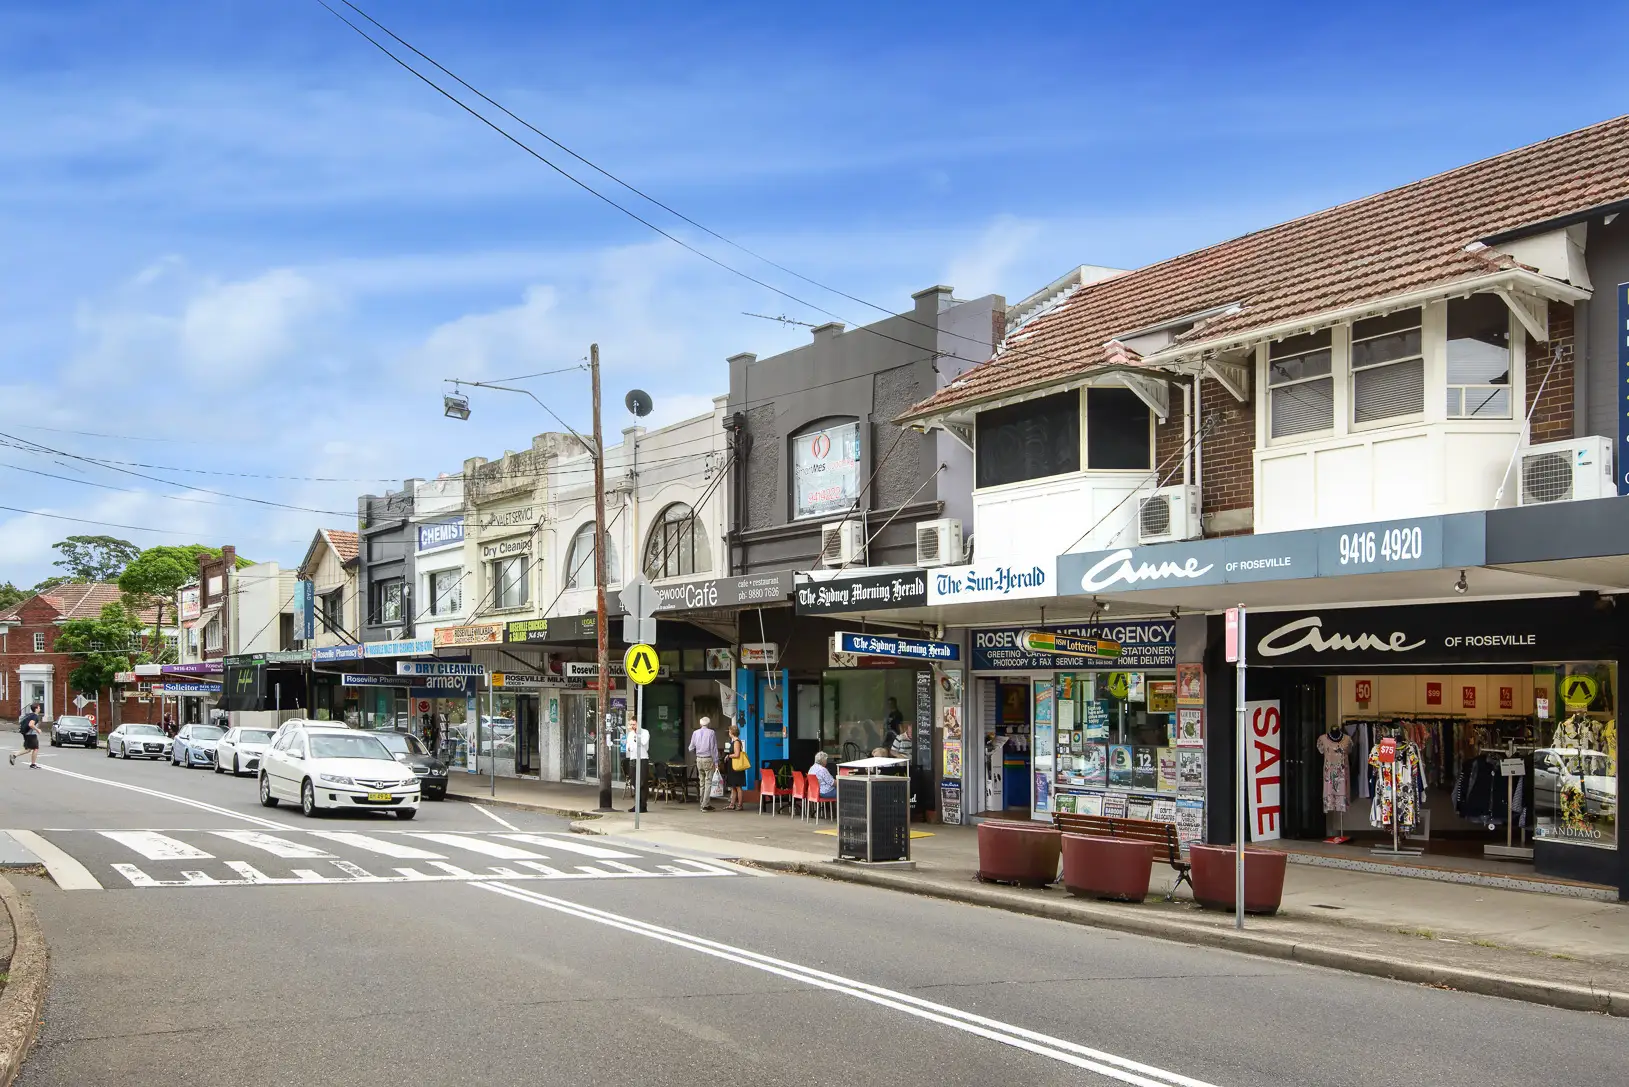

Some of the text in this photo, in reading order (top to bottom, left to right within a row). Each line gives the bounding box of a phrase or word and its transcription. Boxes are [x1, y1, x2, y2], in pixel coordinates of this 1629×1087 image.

[421, 519, 464, 545] CHEMIST
[484, 540, 533, 557] Dry Cleaning
[1226, 526, 1422, 572] OF ROSEVILLE 9416 4920
[752, 576, 779, 585] restaurant
[936, 566, 1045, 596] The Sun-Herald
[656, 581, 718, 608] ewood Café
[748, 589, 763, 599] 9880
[799, 577, 925, 606] The Sydney Morning Herald
[977, 625, 1175, 648] ROSEV WAGENCY
[1445, 637, 1462, 646] OF
[1465, 634, 1536, 646] ROSEVILLE
[853, 637, 951, 657] The Sydney Morning Herald
[1055, 638, 1097, 653] NSW Lotteries
[318, 650, 334, 659] Roseville
[336, 648, 357, 659] Pharmacy
[987, 650, 1021, 658] GREETING
[1121, 646, 1176, 656] STATIONERY
[993, 658, 1028, 667] PHOTOCOPY
[1031, 658, 1038, 666] &
[1039, 658, 1052, 666] FAX
[1055, 657, 1083, 666] SERVICE
[1117, 656, 1138, 665] HOME
[1140, 656, 1175, 665] DELIVERY
[415, 663, 484, 675] DRY CLEANING
[571, 664, 599, 674] Rosevill
[346, 675, 412, 685] Roseville Pharmacy
[426, 675, 467, 691] armacy
[505, 674, 546, 683] ROSEVILLE
[547, 676, 565, 684] MILK
[165, 683, 199, 691] Solicitor
[1380, 745, 1394, 754] $75
[1252, 706, 1280, 836] SALE
[1552, 826, 1602, 839] ANDIAMO
